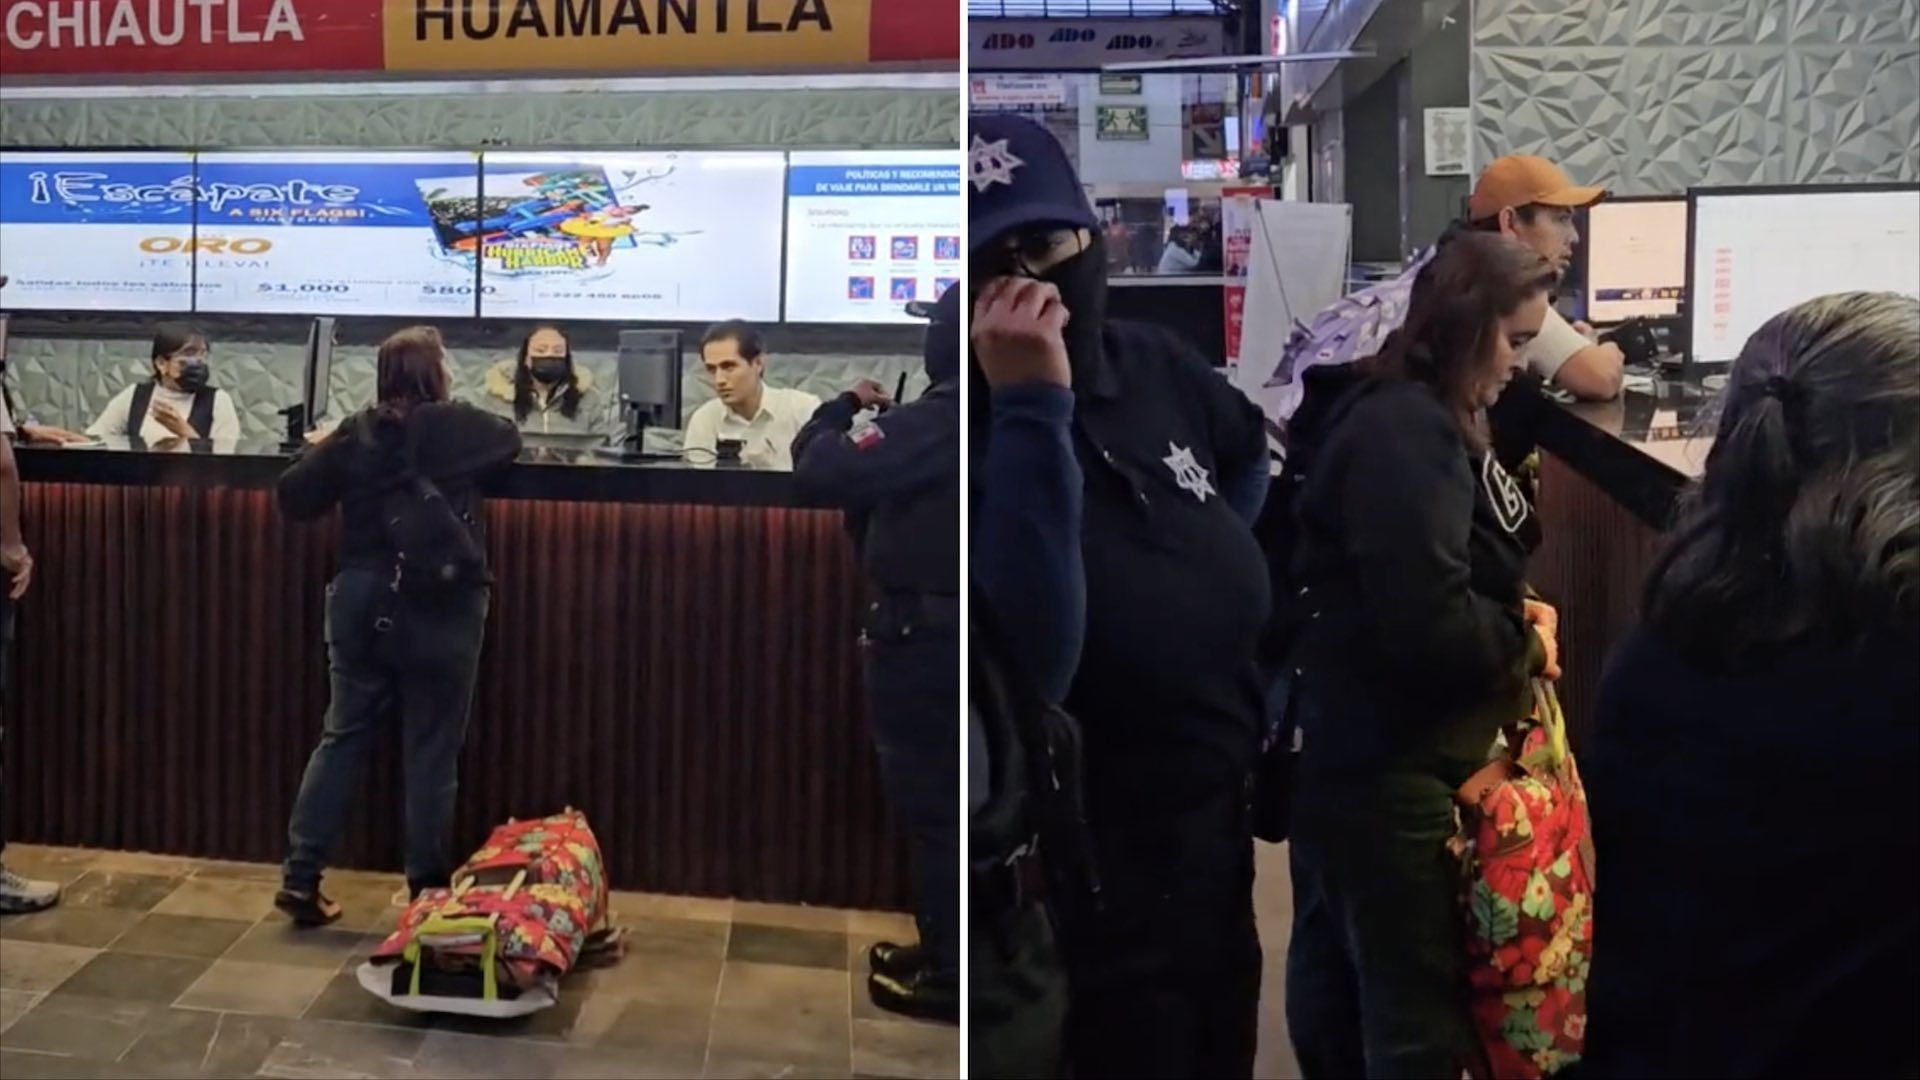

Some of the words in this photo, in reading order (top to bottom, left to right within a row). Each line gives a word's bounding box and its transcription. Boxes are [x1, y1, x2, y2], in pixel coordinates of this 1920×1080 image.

[5, 0, 304, 49] CHIAUTLA
[415, 0, 833, 41] HUAMANTLA
[982, 33, 1035, 49] ADO
[1048, 28, 1096, 42] ADO
[1105, 35, 1153, 50] ADO
[29, 171, 359, 211] ¡Escápate
[855, 183, 879, 193] PARA
[229, 208, 243, 217] A
[249, 208, 283, 217] SIX
[289, 208, 365, 218] FLAGS!
[138, 237, 273, 255] ORO
[257, 283, 350, 297] $1,000
